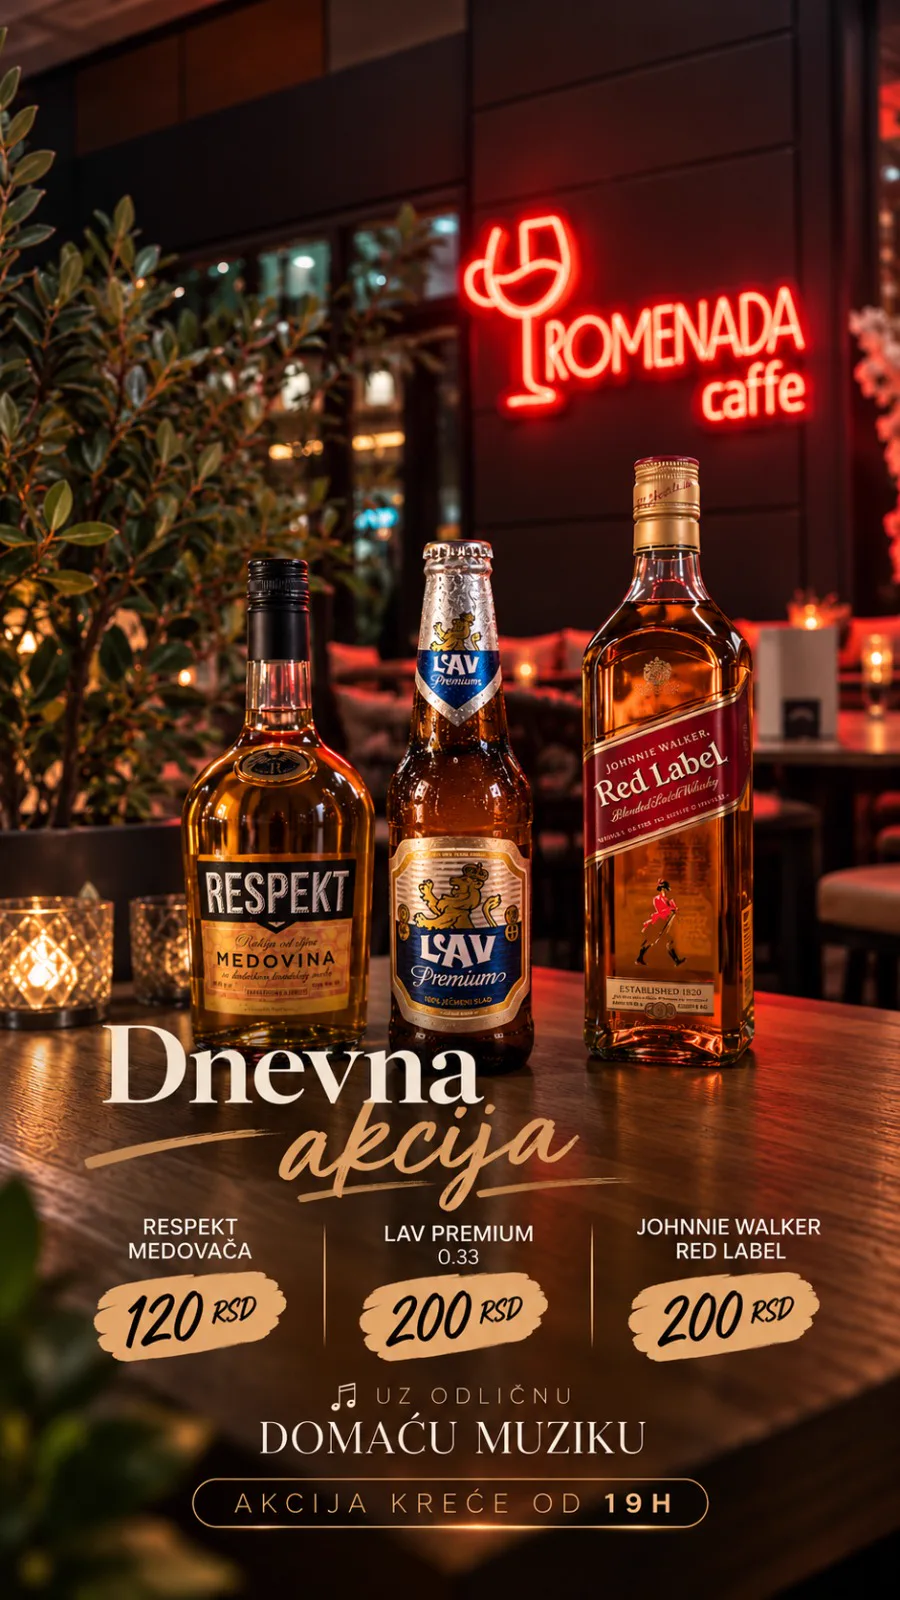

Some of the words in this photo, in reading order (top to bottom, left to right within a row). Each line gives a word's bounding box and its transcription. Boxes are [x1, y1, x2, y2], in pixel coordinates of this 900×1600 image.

[701, 358, 806, 422] caffe
[433, 654, 480, 676] LAV
[593, 768, 650, 808] Red
[649, 741, 729, 788] Label
[606, 747, 657, 775] JOHNNIE
[610, 796, 652, 823] Blended
[205, 870, 350, 915] RESPEKT
[216, 950, 336, 969] MEDOVINA
[420, 933, 497, 969] LAV
[410, 964, 507, 988] Premium
[619, 985, 680, 996] ESTABLISHED
[682, 987, 702, 997] 1820
